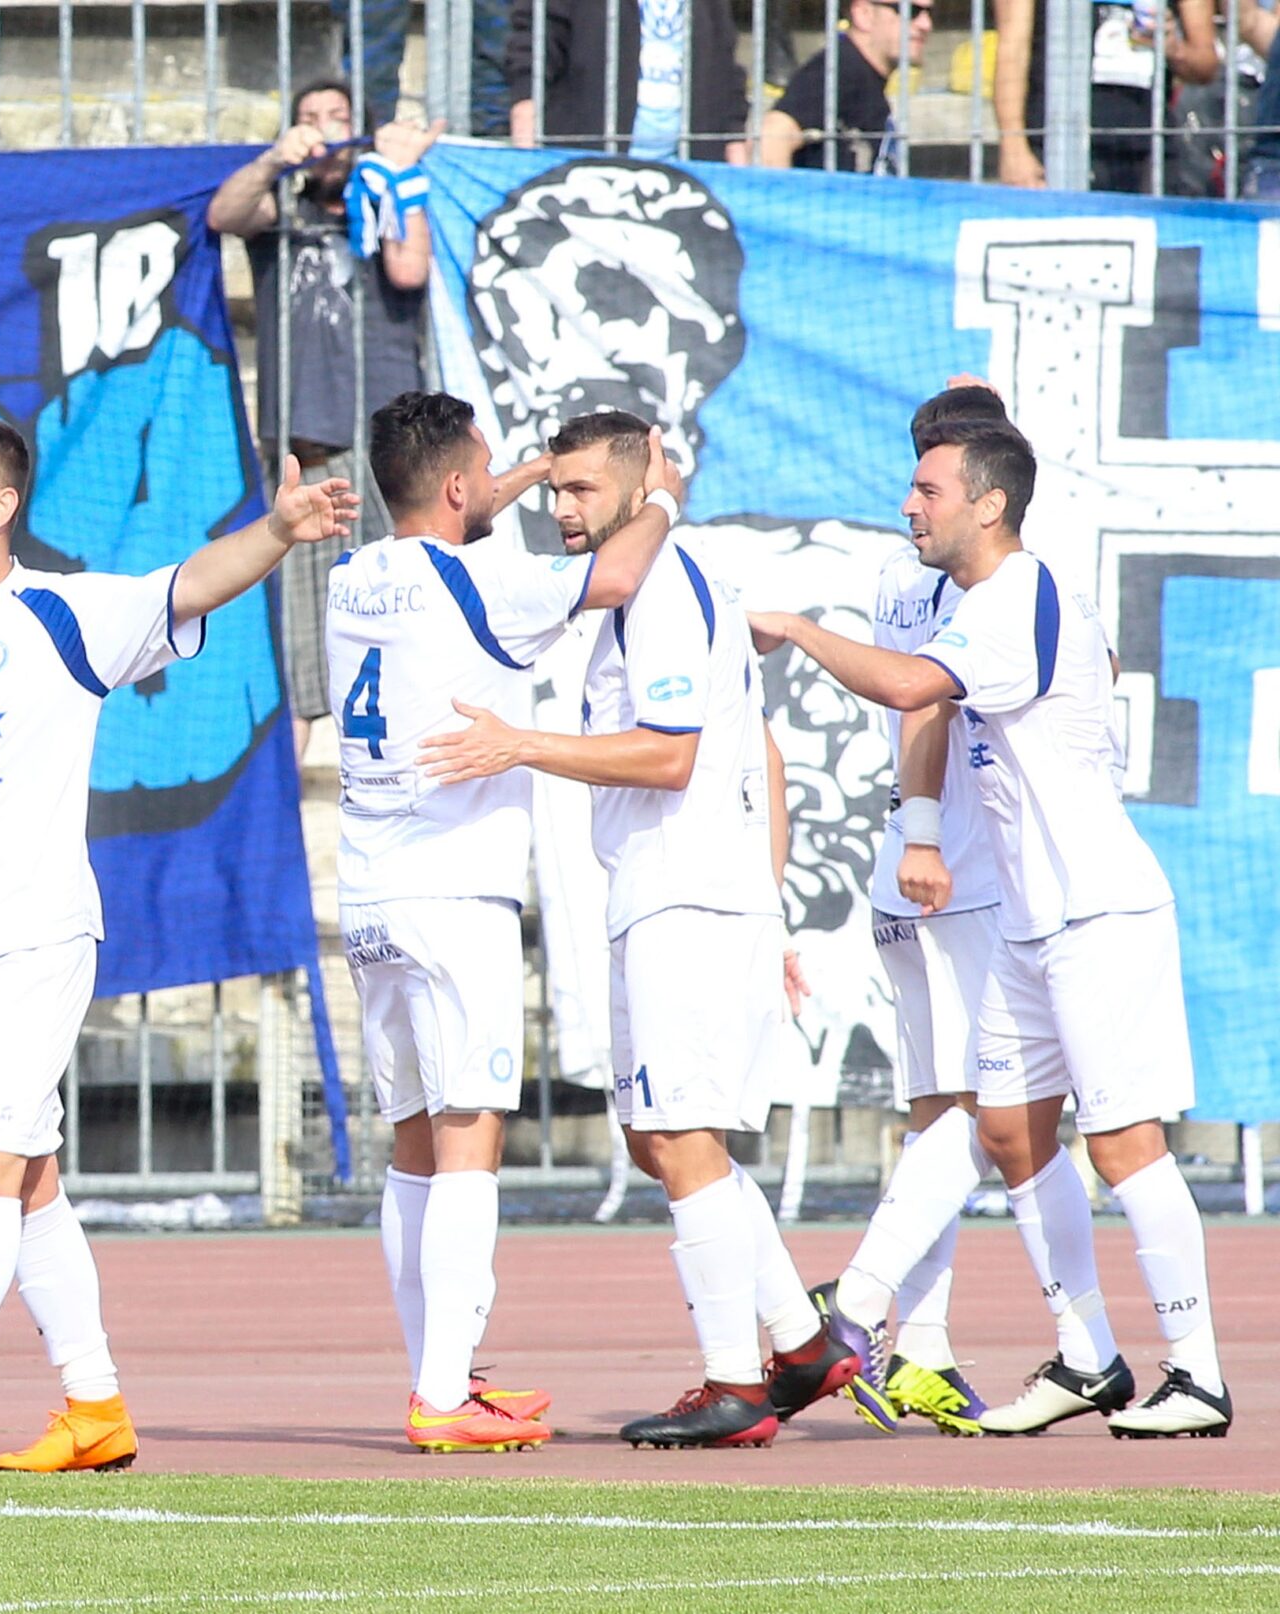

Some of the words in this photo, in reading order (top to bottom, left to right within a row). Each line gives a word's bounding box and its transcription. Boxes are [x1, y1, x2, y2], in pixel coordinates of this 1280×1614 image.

[342, 646, 388, 760] 4
[1042, 1281, 1062, 1298] AP
[1154, 1296, 1198, 1314] CAP
